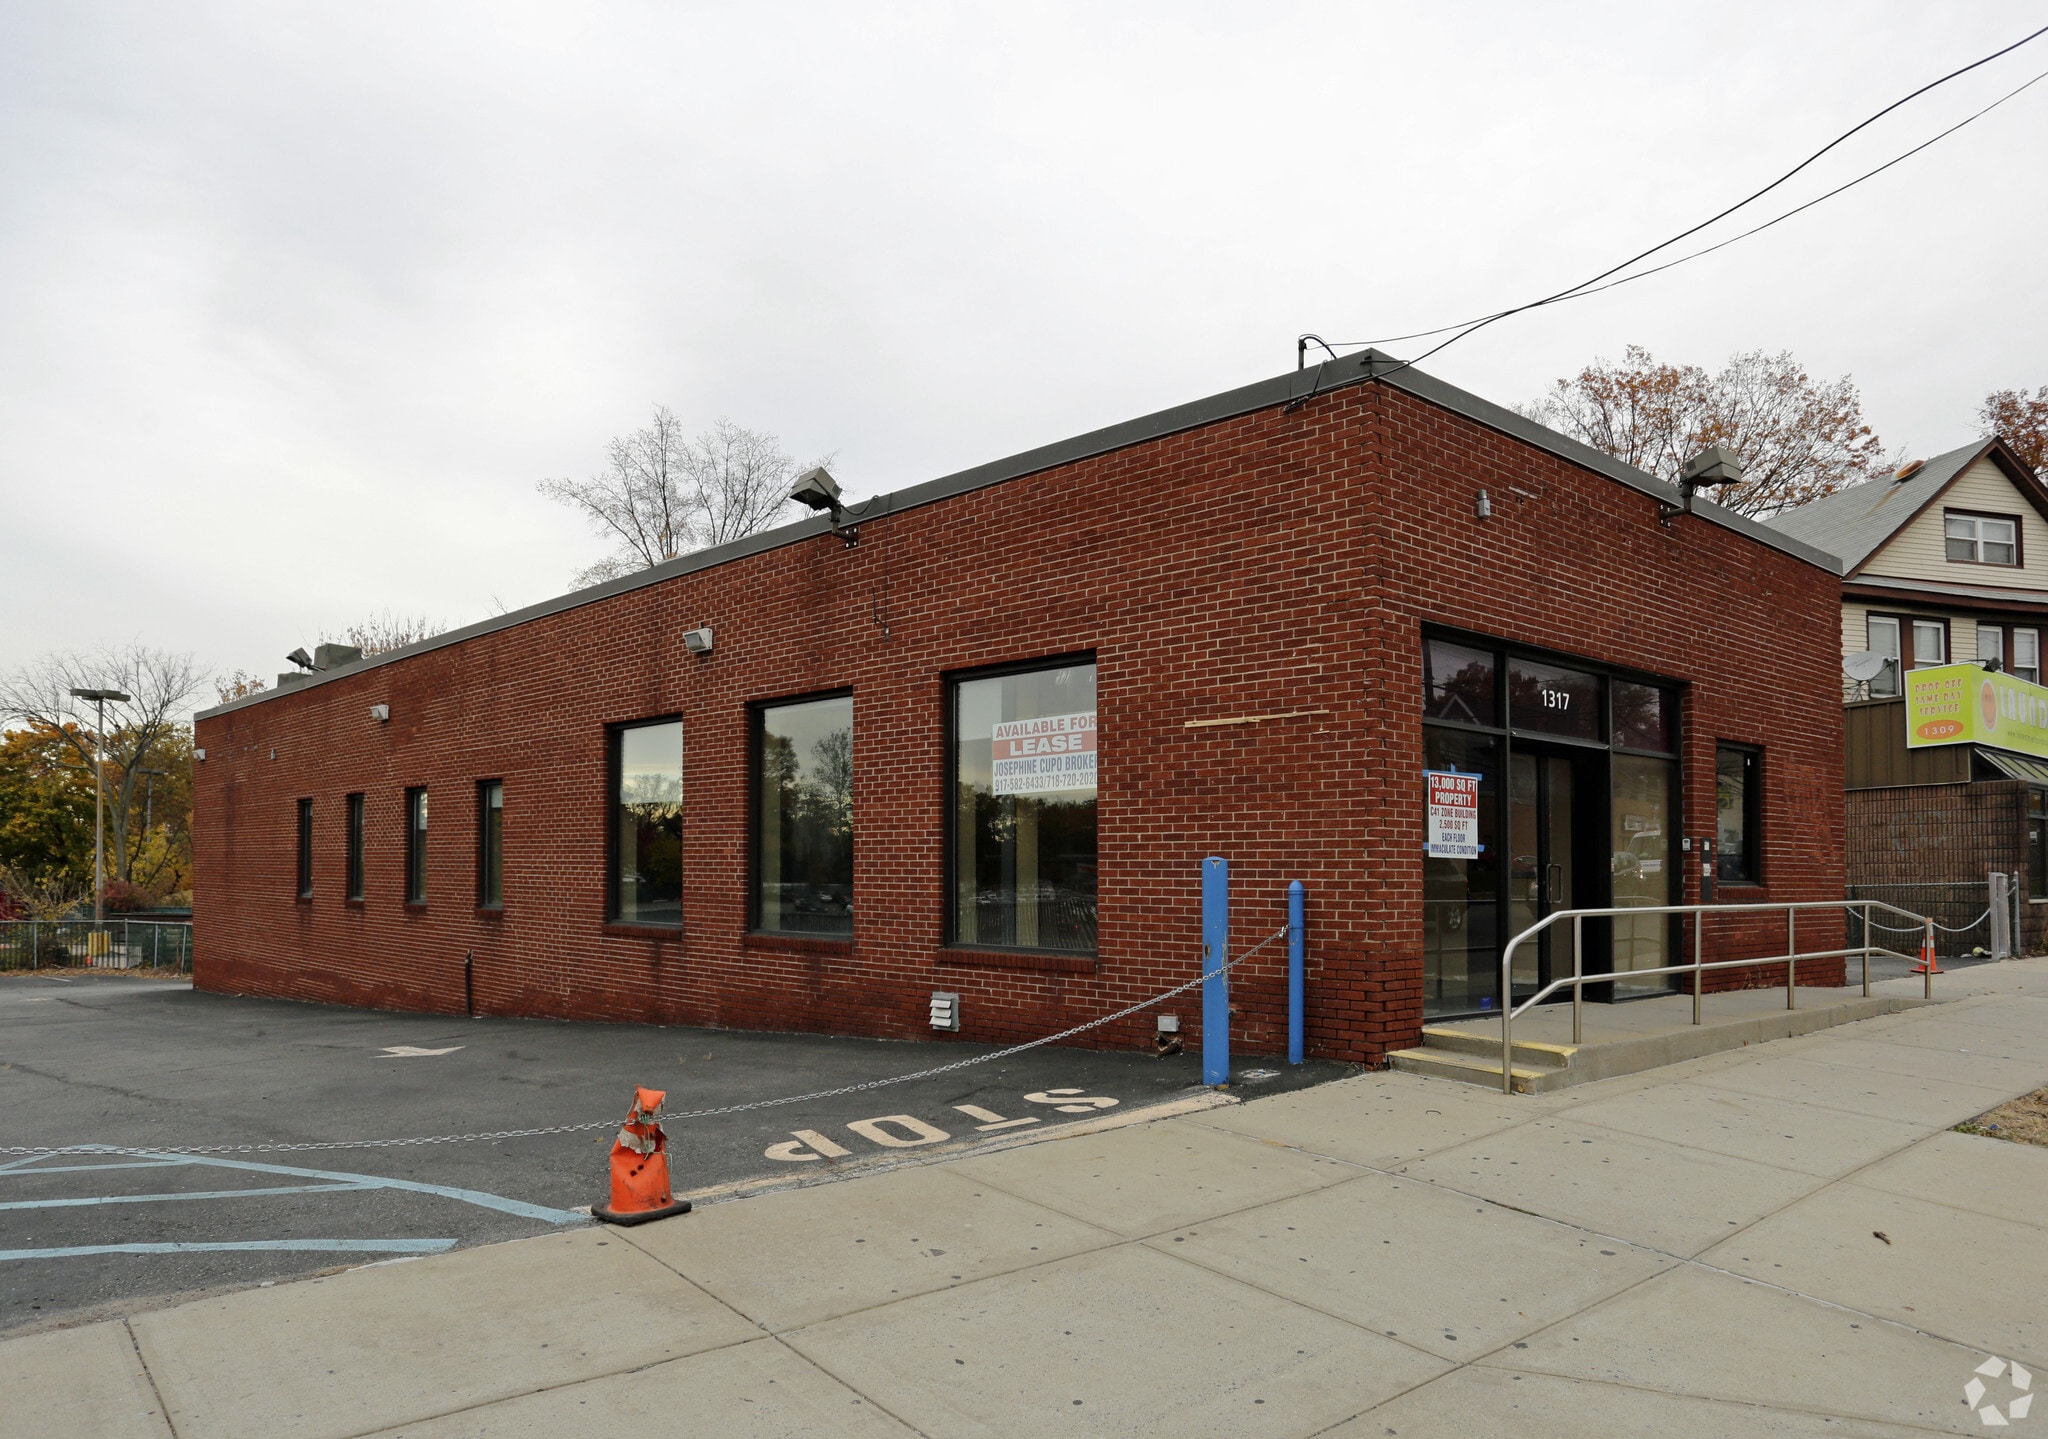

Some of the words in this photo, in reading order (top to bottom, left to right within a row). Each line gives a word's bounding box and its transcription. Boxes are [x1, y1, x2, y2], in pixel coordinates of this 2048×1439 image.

[1915, 682, 1941, 693] DROP
[1944, 678, 1963, 688] OFF
[1541, 689, 1570, 710] 1317
[1915, 693, 1939, 705] SAME
[1943, 689, 1963, 701] DAY
[1919, 703, 1960, 716] SERVICE
[996, 718, 1065, 738] AVAILABLE
[1070, 715, 1097, 730] FOR
[1924, 724, 1955, 736] 1309
[1010, 733, 1082, 756] LEASE
[994, 760, 1037, 777] JOSEPHINE
[1040, 756, 1062, 773] CUPO
[1430, 776, 1455, 790] 13,000
[1456, 779, 1466, 792] SQ
[1467, 780, 1476, 792] FT
[1435, 792, 1472, 806] PROPERTY
[1441, 808, 1454, 817] ZONE
[1455, 809, 1476, 819] BUILDING
[1454, 820, 1461, 830] SQ
[1462, 821, 1468, 830] FT
[1442, 832, 1452, 842] EACH
[1453, 833, 1466, 843] FLOOR
[1457, 846, 1477, 855] CONDITION
[764, 1088, 1120, 1161] STOP
